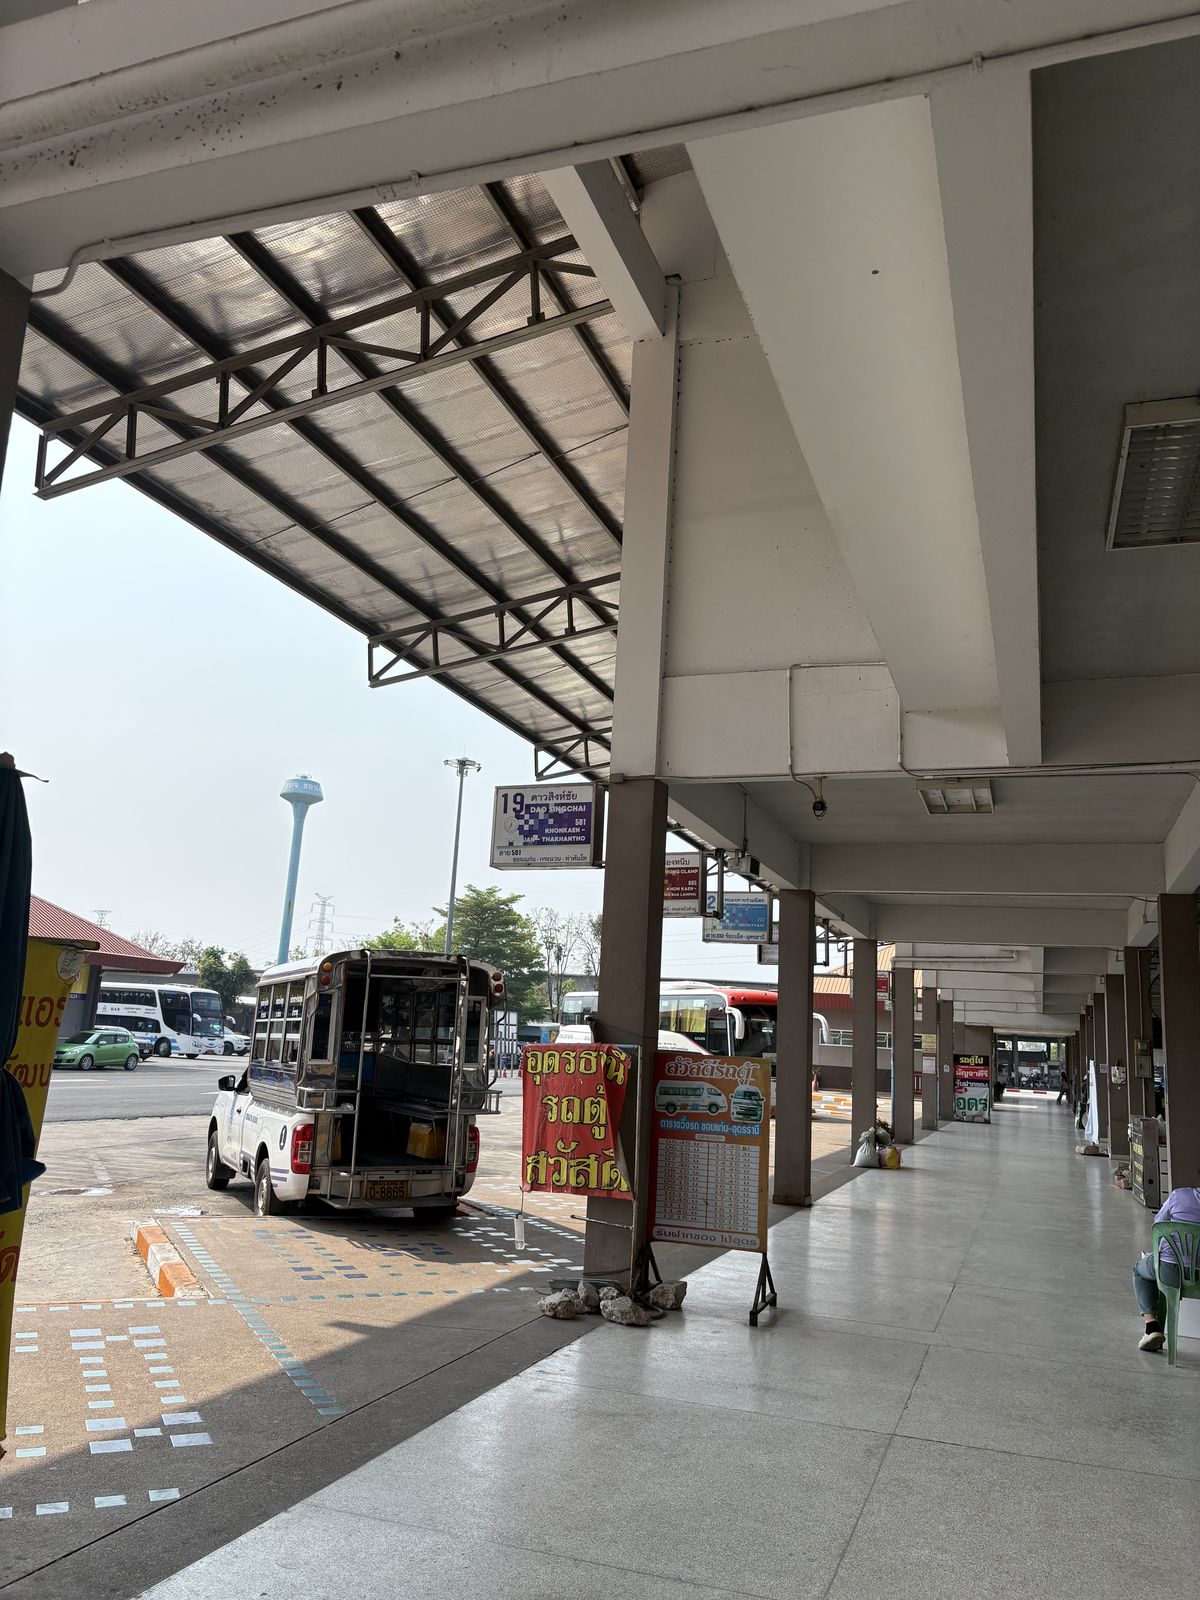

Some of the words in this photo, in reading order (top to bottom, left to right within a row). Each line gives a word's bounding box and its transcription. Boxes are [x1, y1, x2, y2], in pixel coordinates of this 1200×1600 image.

[502, 792, 524, 814] 19
[549, 805, 586, 813] SINGCHAI
[526, 1049, 628, 1086] อุดรธานี
[542, 1084, 608, 1140] รถตู้
[956, 1097, 987, 1116] อุดร
[660, 1116, 699, 1130] ตารางวิ่งรถ
[656, 1228, 716, 1241] รับฝากของ
